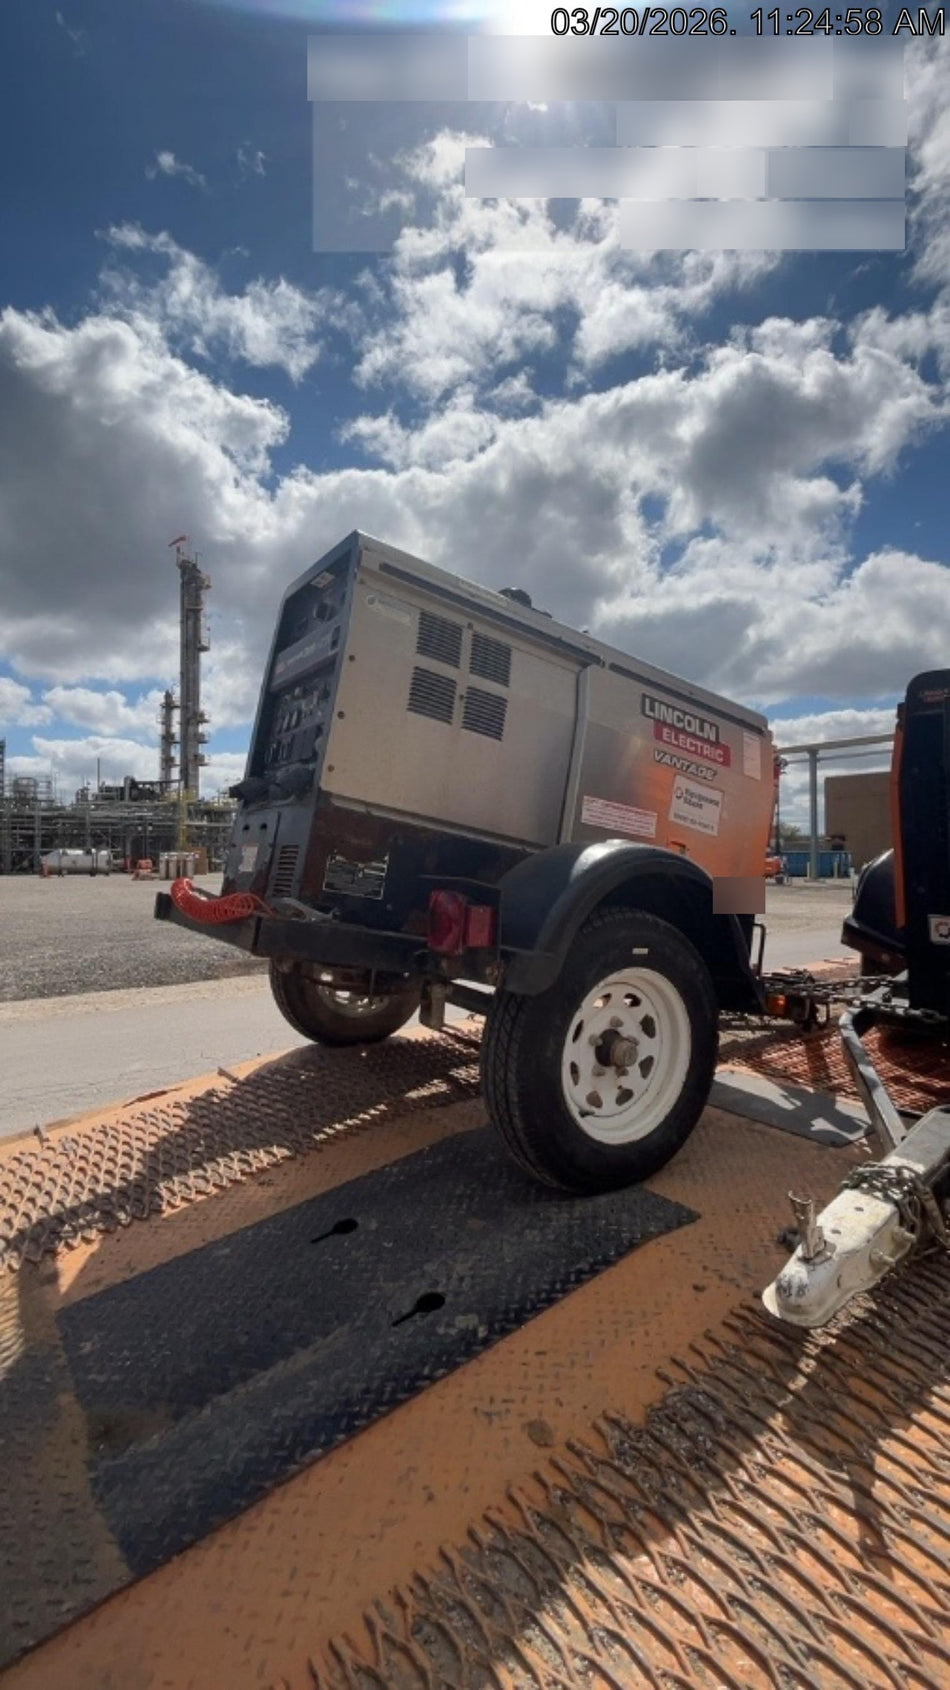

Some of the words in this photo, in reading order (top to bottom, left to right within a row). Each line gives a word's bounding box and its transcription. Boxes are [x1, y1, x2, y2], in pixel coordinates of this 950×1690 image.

[644, 697, 718, 743] LINCOLN
[661, 727, 725, 763] ELECTRIC
[653, 749, 716, 780] VANTAGE
